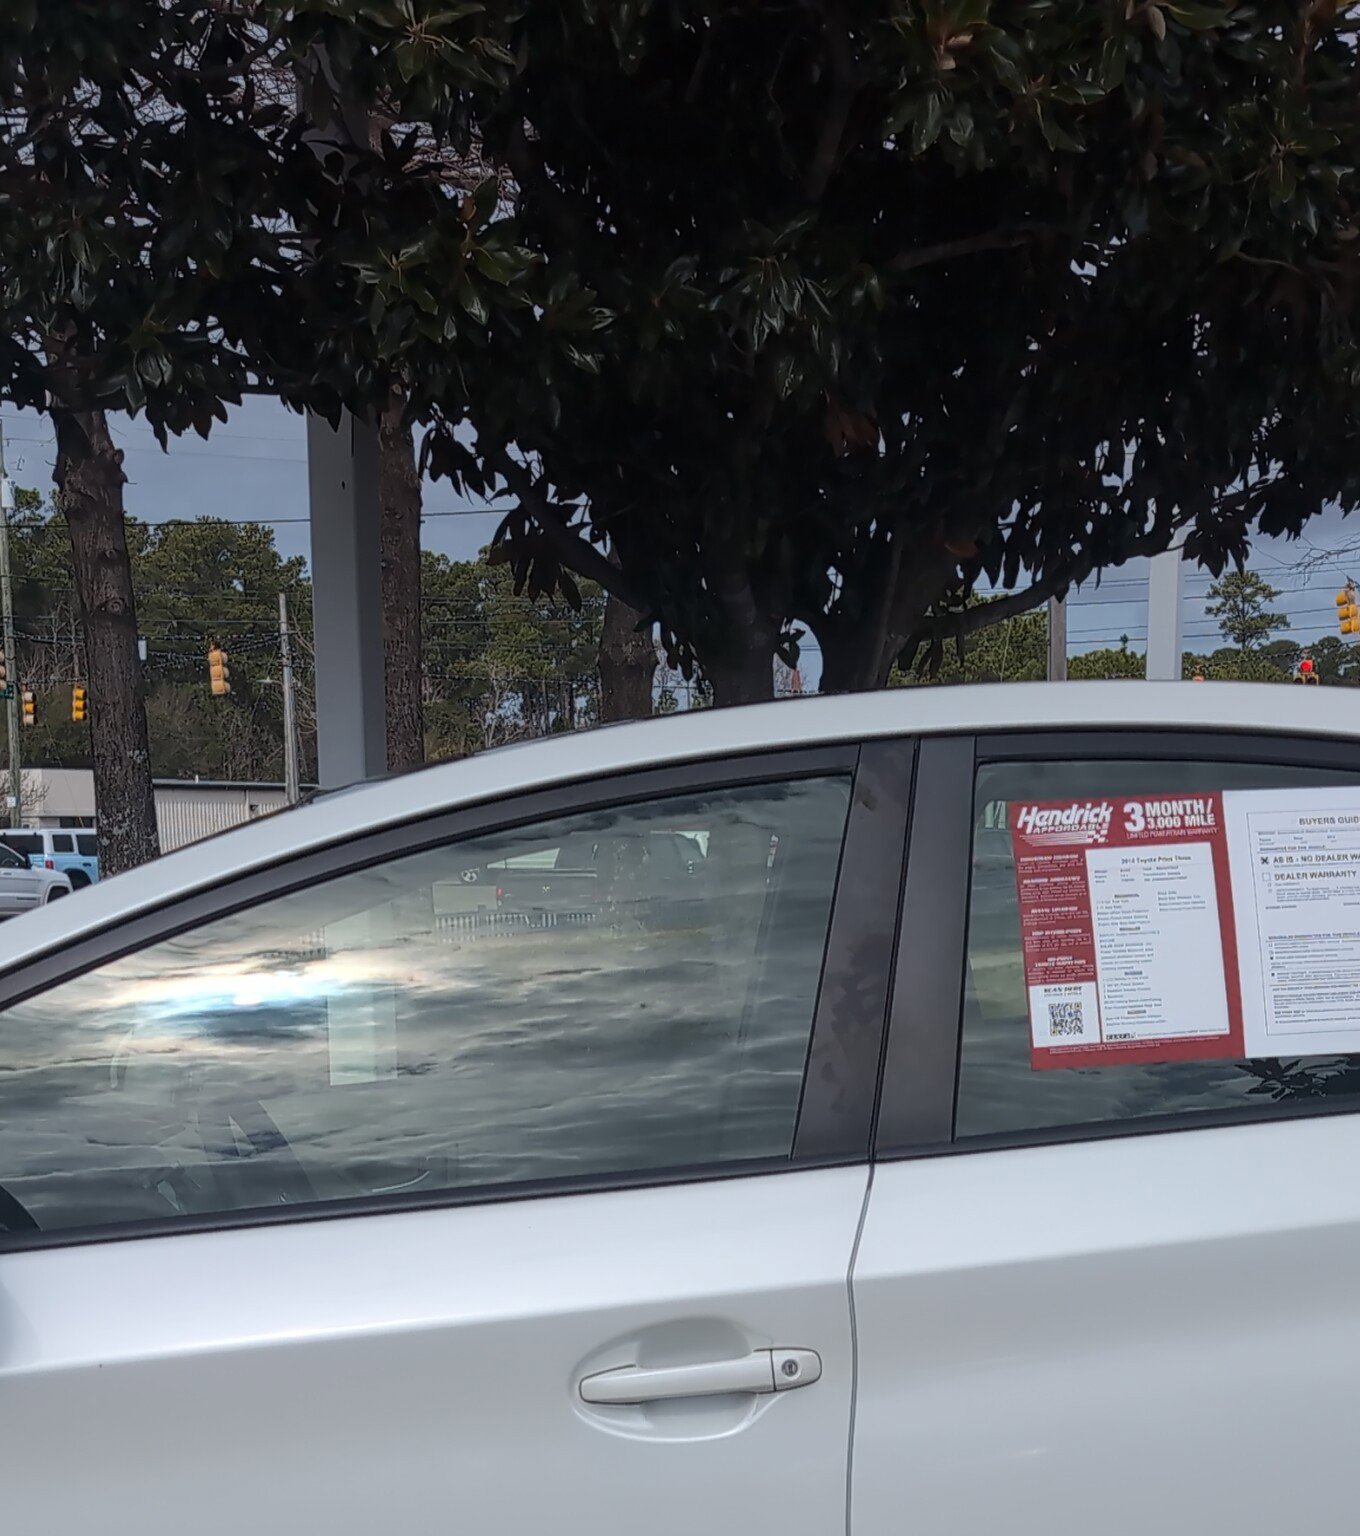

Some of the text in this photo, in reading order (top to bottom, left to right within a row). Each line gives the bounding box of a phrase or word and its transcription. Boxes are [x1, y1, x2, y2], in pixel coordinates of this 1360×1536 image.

[1017, 802, 1113, 834] Hendrick
[1123, 798, 1213, 832] 3 MONTH/
[1147, 813, 1216, 830] 3,000 MILE
[1299, 817, 1336, 825] BUYERS
